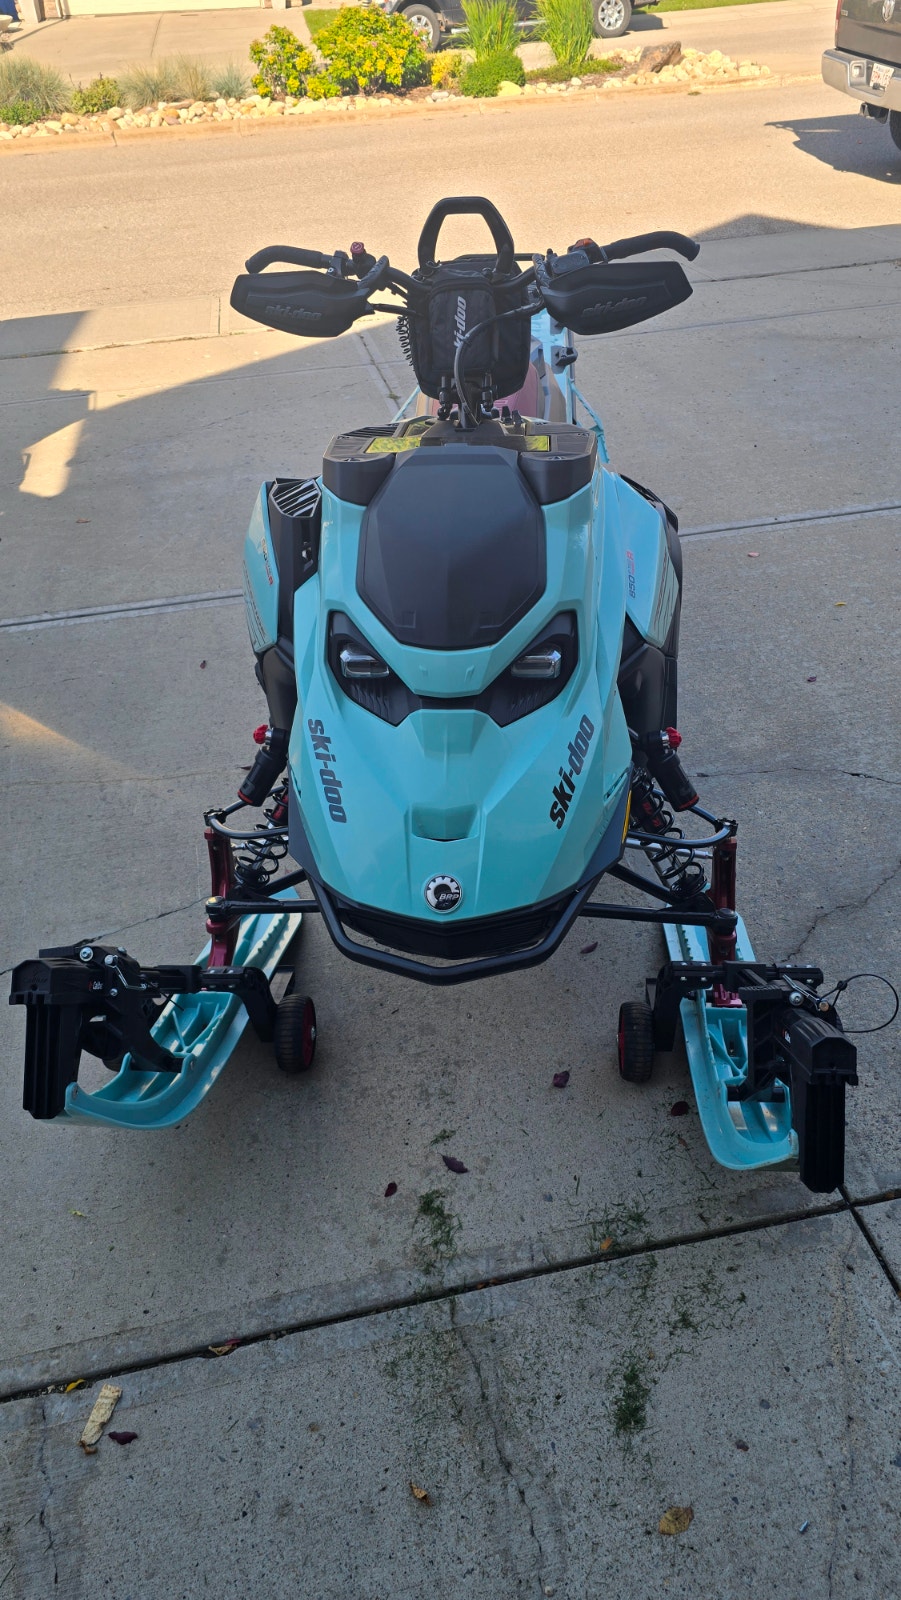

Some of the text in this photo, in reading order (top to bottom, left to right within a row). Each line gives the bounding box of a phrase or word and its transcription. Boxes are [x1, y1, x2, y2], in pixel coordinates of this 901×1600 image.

[265, 304, 323, 320] ski-doo
[580, 295, 648, 318] ski-doo
[308, 718, 347, 823] ski-doo
[549, 713, 595, 830] ski-doo
[438, 893, 460, 902] BRP
